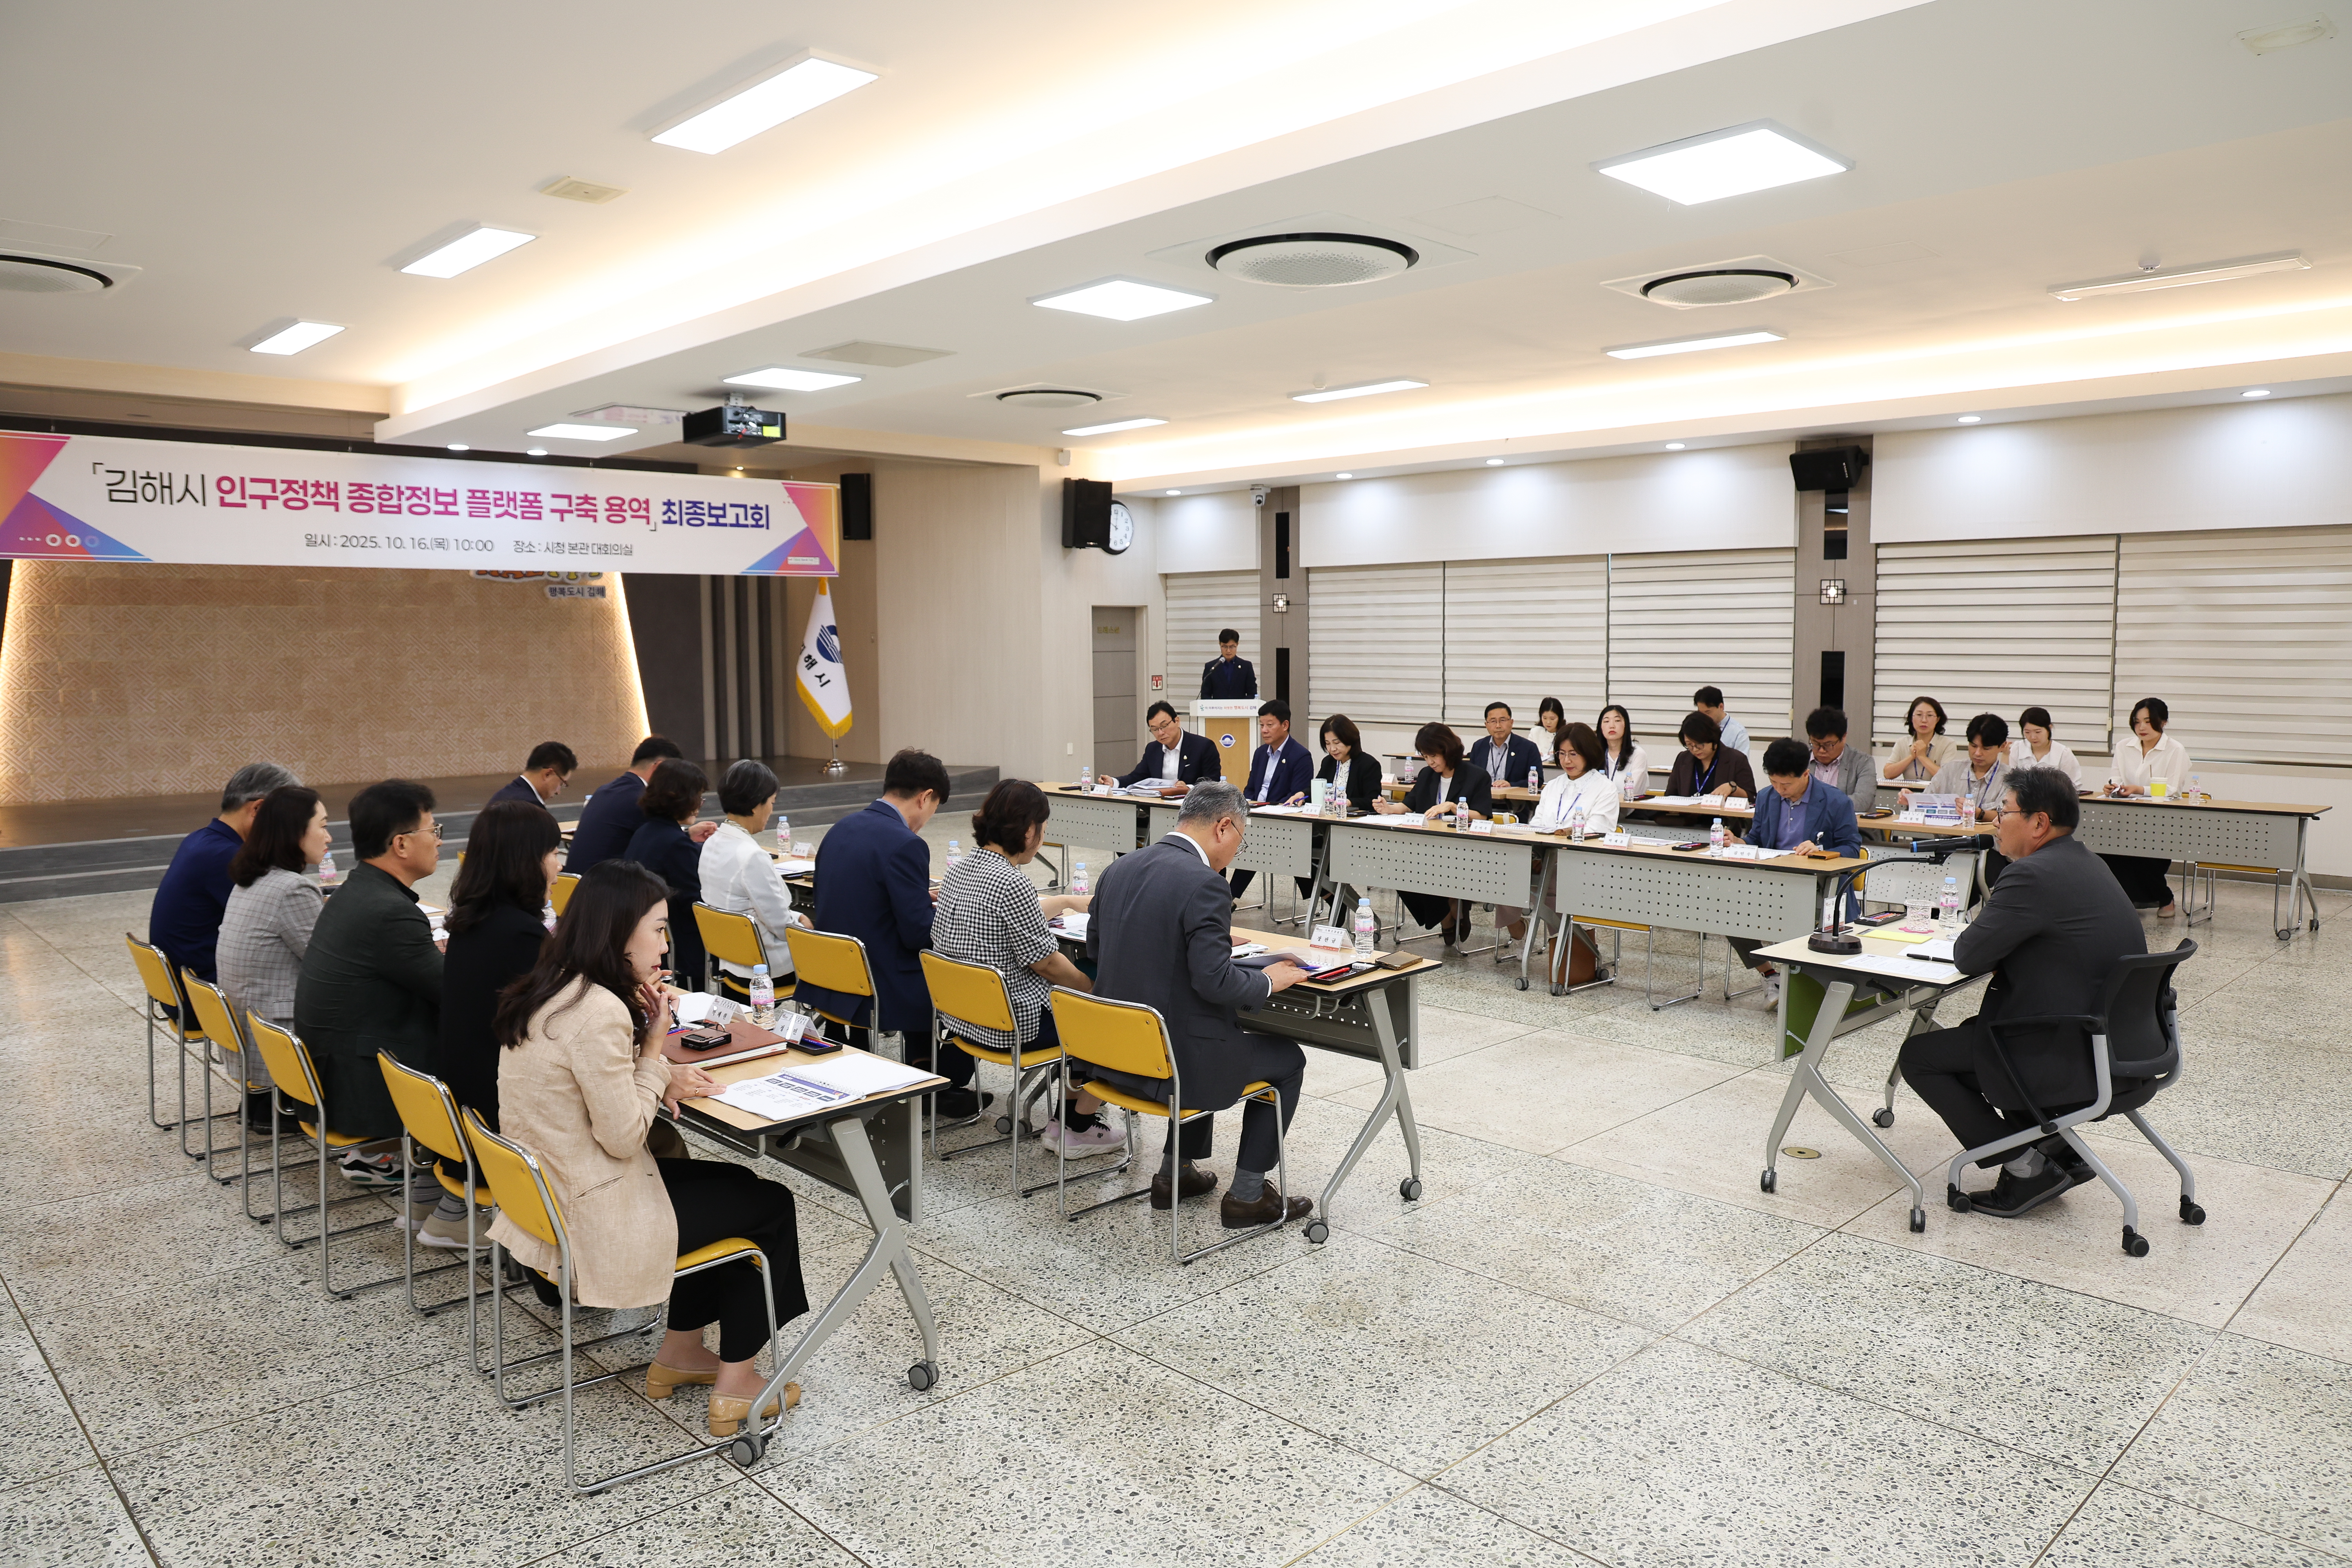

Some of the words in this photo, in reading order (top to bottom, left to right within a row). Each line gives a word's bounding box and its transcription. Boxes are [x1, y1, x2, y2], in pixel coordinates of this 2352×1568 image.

[216, 475, 339, 512] 인구정책
[347, 482, 459, 516] 종합정보
[466, 488, 543, 520] 플랫폼
[550, 494, 598, 523] 구축
[662, 499, 769, 530] 최종보고회
[305, 534, 330, 547] 일시
[340, 535, 381, 548] 2025.
[385, 536, 405, 549] 10.
[454, 539, 494, 552] 10:00
[513, 540, 536, 553] 장소
[544, 541, 565, 554] 시청
[568, 542, 589, 555] 본관
[592, 543, 633, 555] 대회의실
